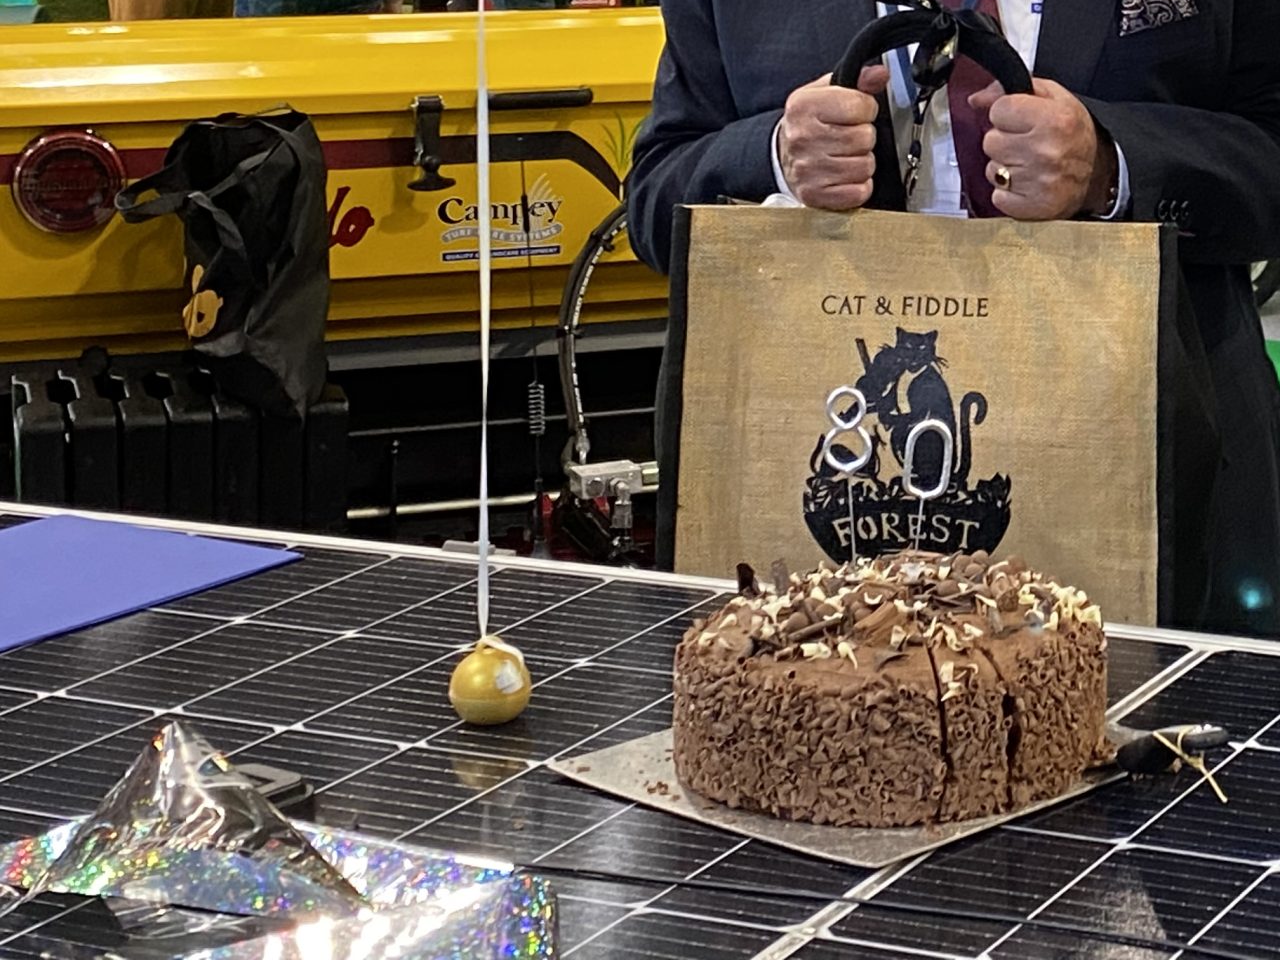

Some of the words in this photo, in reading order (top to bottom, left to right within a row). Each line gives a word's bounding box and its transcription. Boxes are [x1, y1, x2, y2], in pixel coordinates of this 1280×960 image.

[437, 197, 563, 226] Campey
[821, 294, 866, 315] CAT
[875, 295, 893, 316] &
[901, 295, 989, 318] FIDDLE
[832, 512, 980, 549] FOREST
